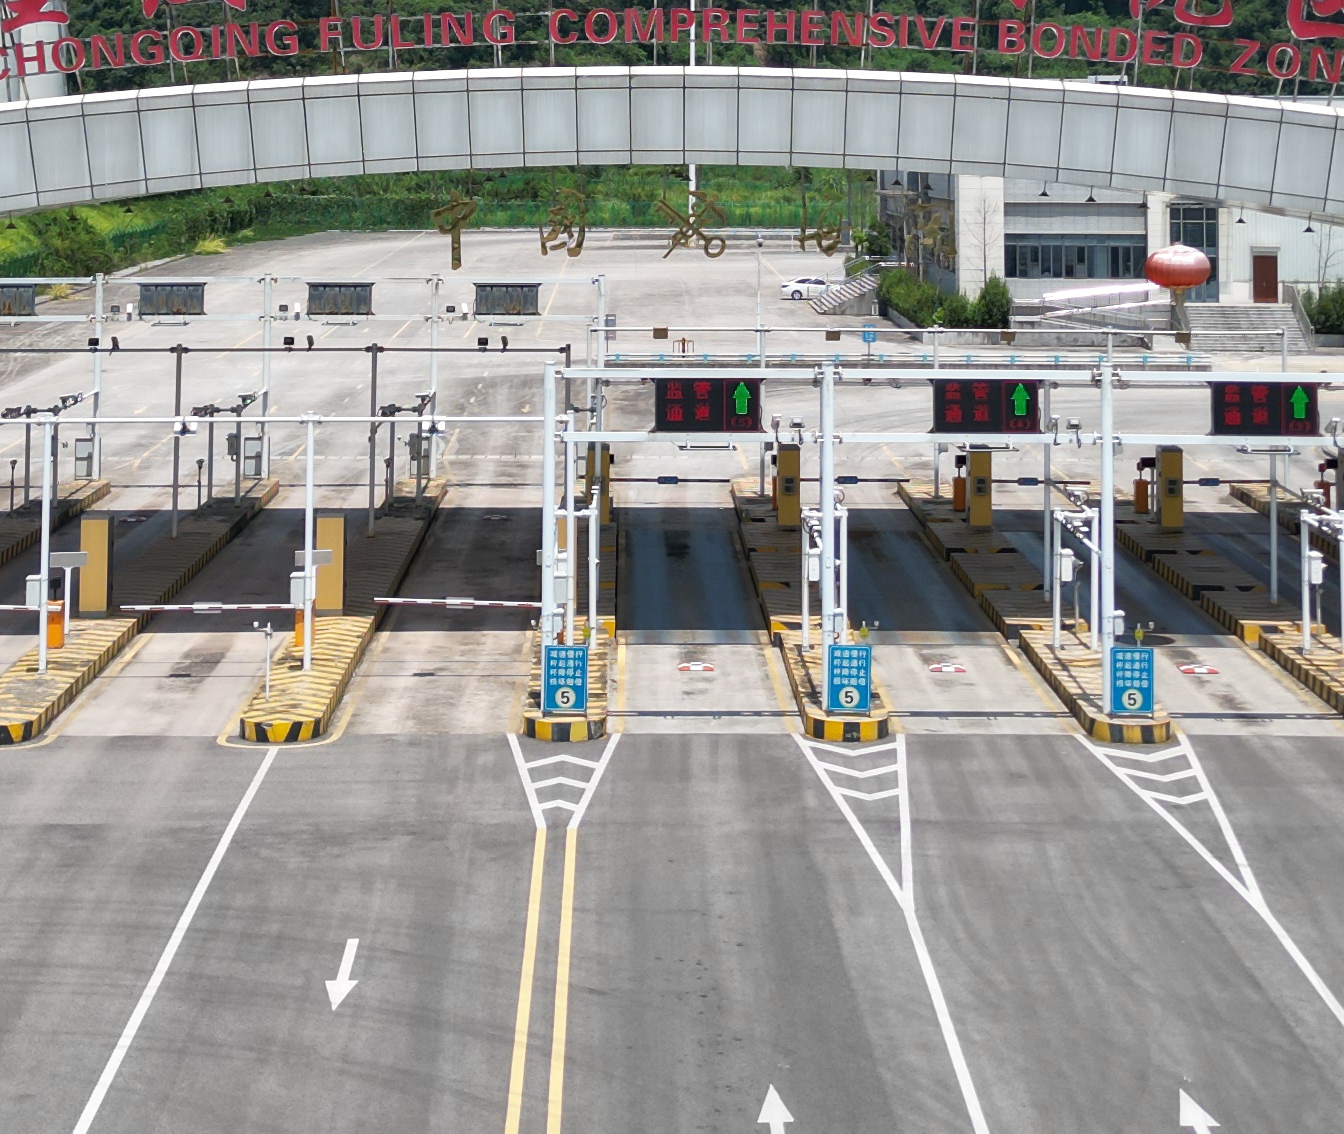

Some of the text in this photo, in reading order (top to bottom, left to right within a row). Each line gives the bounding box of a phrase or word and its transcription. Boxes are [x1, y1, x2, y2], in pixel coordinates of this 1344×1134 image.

[319, 8, 515, 53] FULING
[548, 7, 975, 53] COMPREHENSIVE
[998, 18, 1204, 69] BONDED
[665, 381, 712, 399] 监管
[560, 691, 570, 704] 5
[844, 691, 853, 704] 5
[1127, 693, 1137, 706] 5
